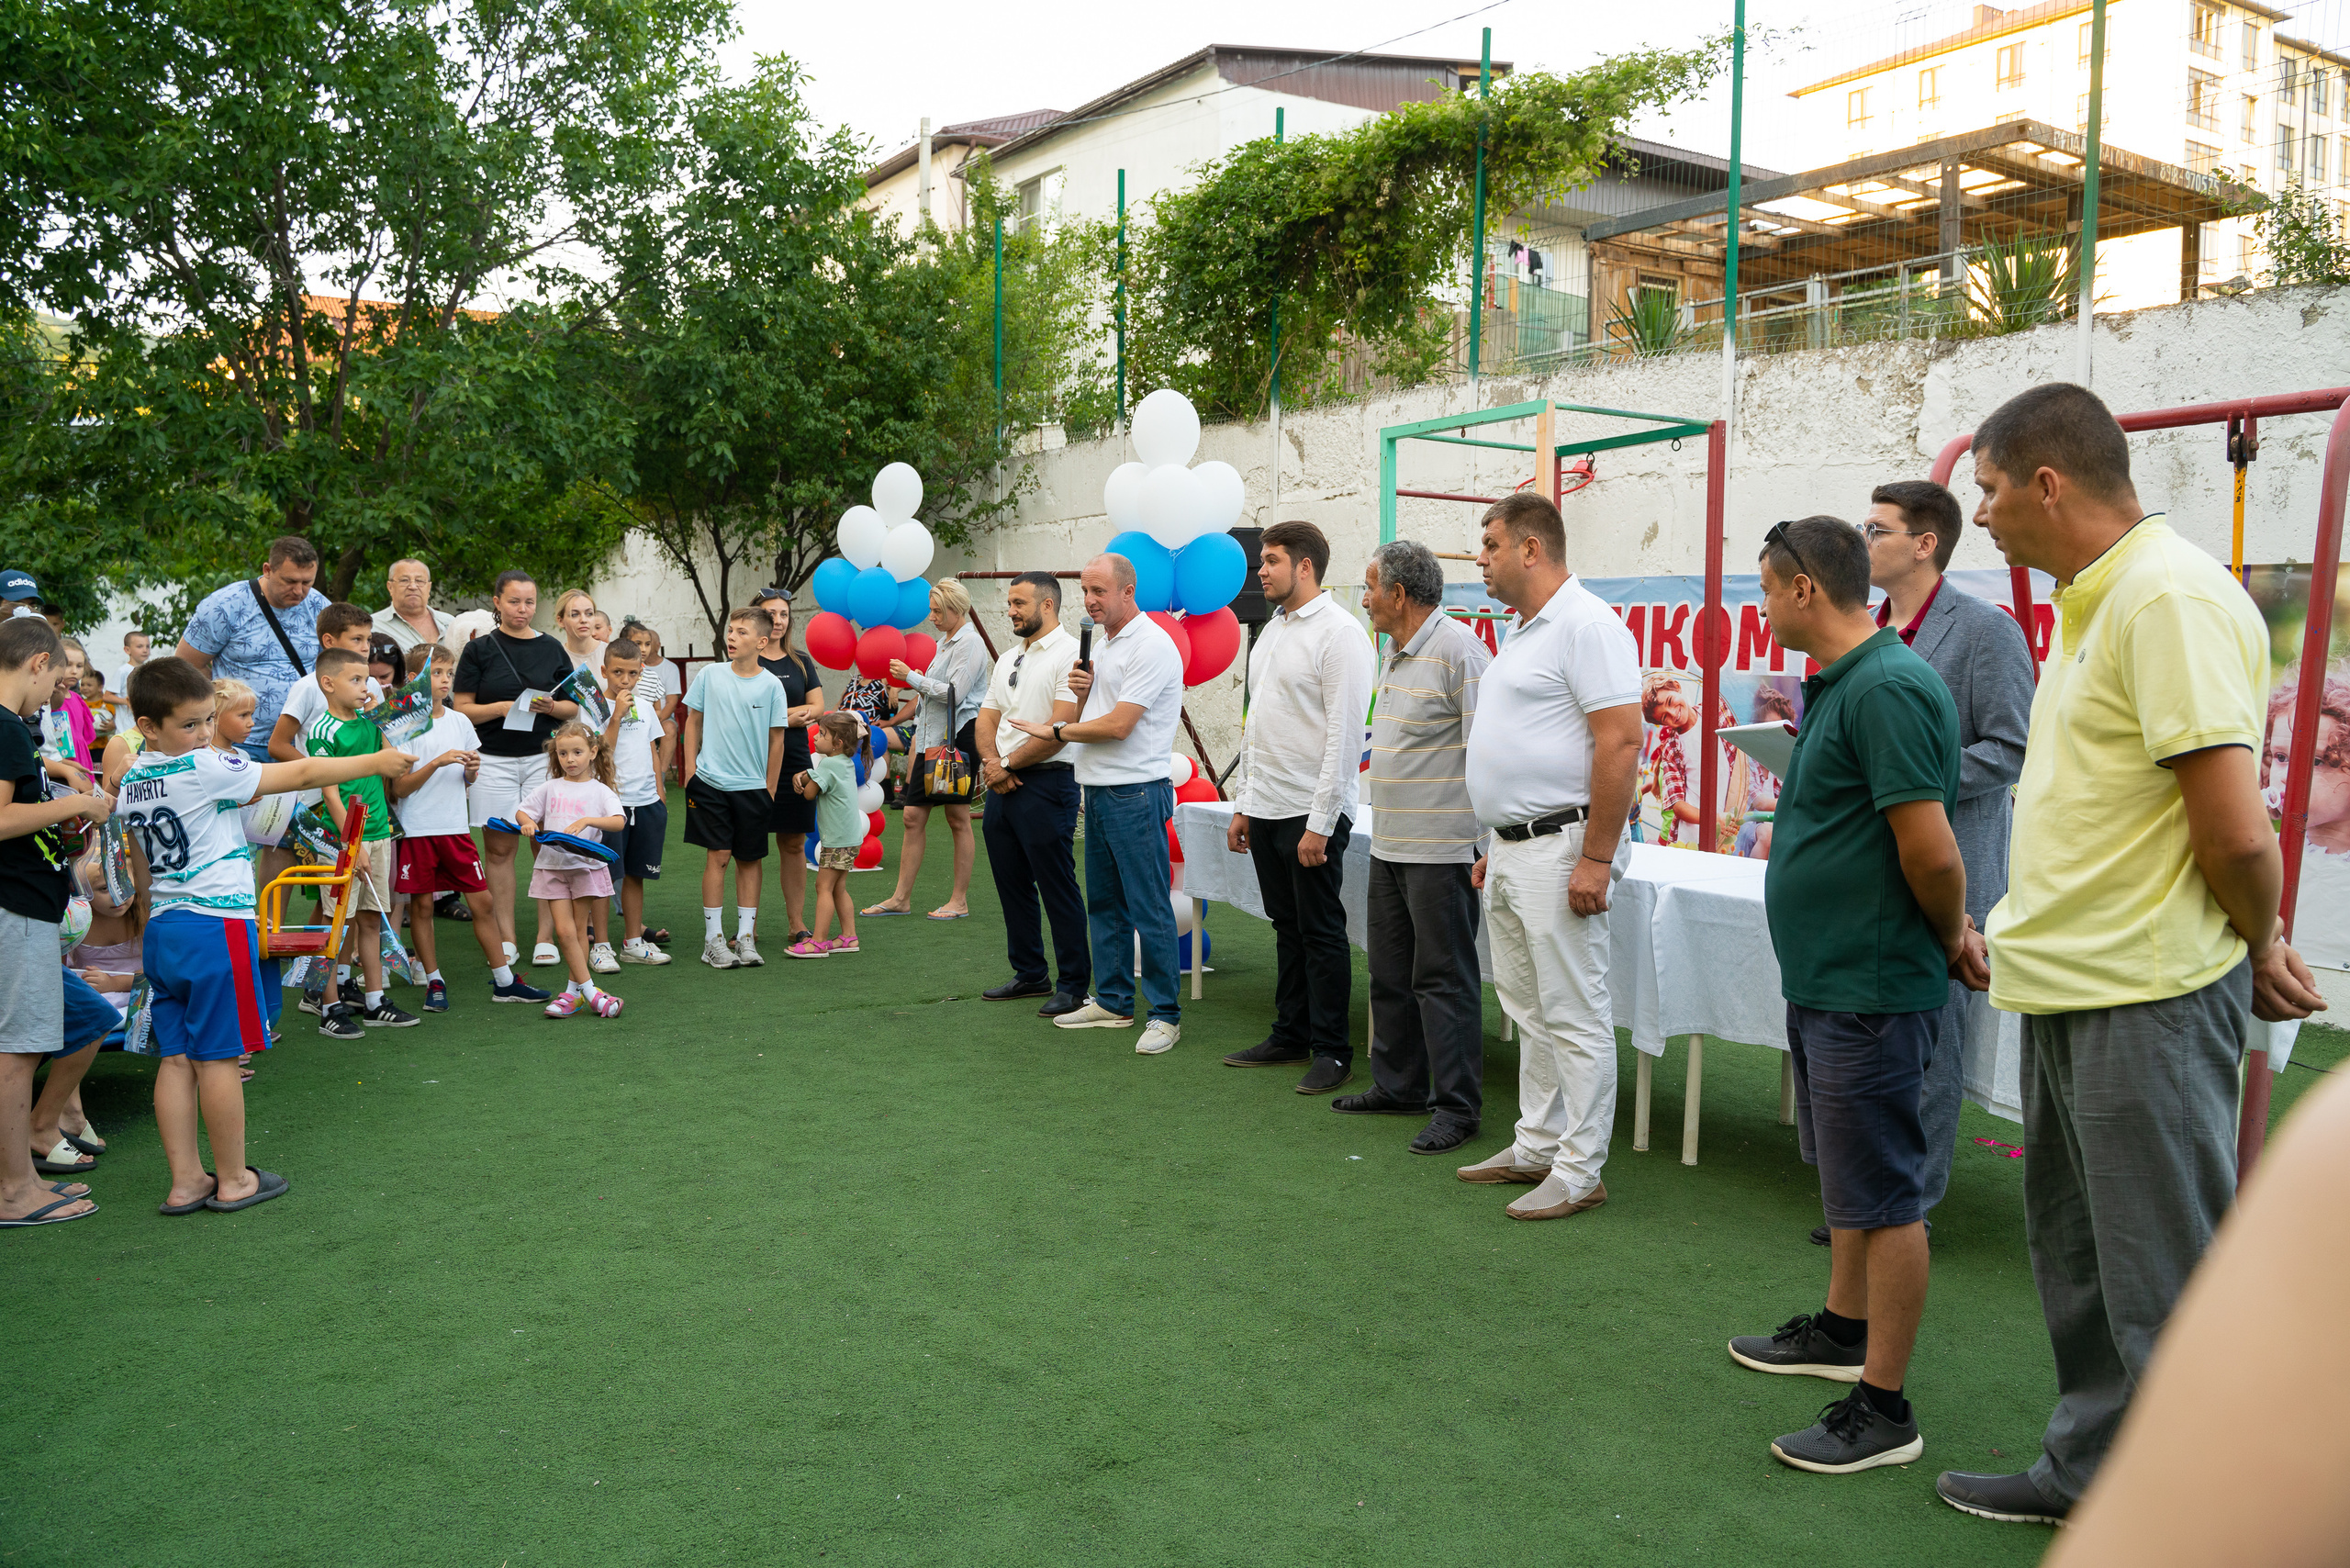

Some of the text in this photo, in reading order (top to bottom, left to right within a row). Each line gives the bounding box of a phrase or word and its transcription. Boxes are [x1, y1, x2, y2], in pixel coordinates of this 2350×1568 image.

[6, 577, 37, 588] adidas
[126, 778, 168, 805] HAVERTZ
[550, 792, 588, 816] PINK
